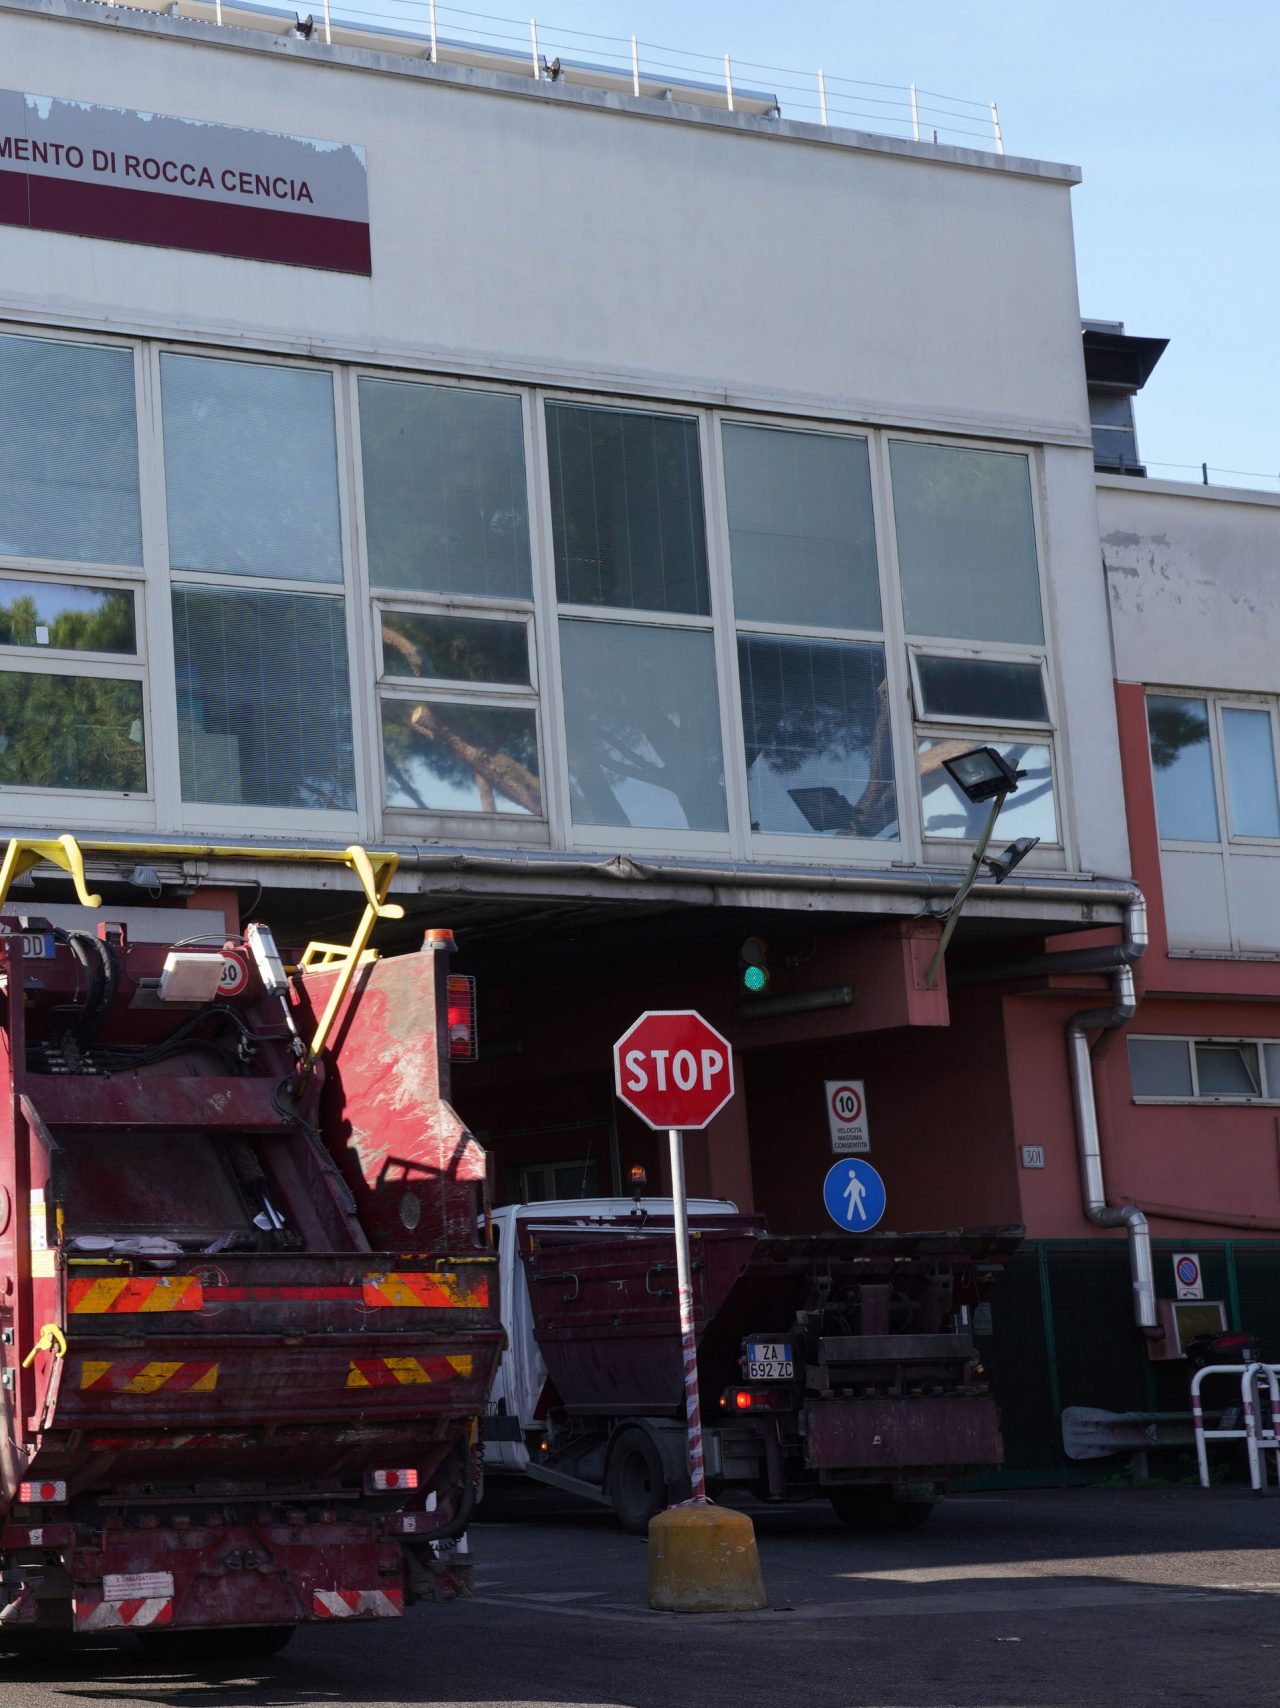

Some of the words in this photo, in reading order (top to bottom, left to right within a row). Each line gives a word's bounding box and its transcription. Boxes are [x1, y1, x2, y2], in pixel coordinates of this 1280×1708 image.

[93, 149, 116, 174] DI
[124, 154, 215, 189] ROCCA
[221, 169, 314, 203] CENCIA
[625, 1049, 724, 1092] STOP
[839, 1095, 855, 1113] 10
[1025, 1150, 1041, 1164] 301
[762, 1345, 778, 1360] ZA
[750, 1363, 774, 1378] 692
[777, 1362, 793, 1377] ZC
